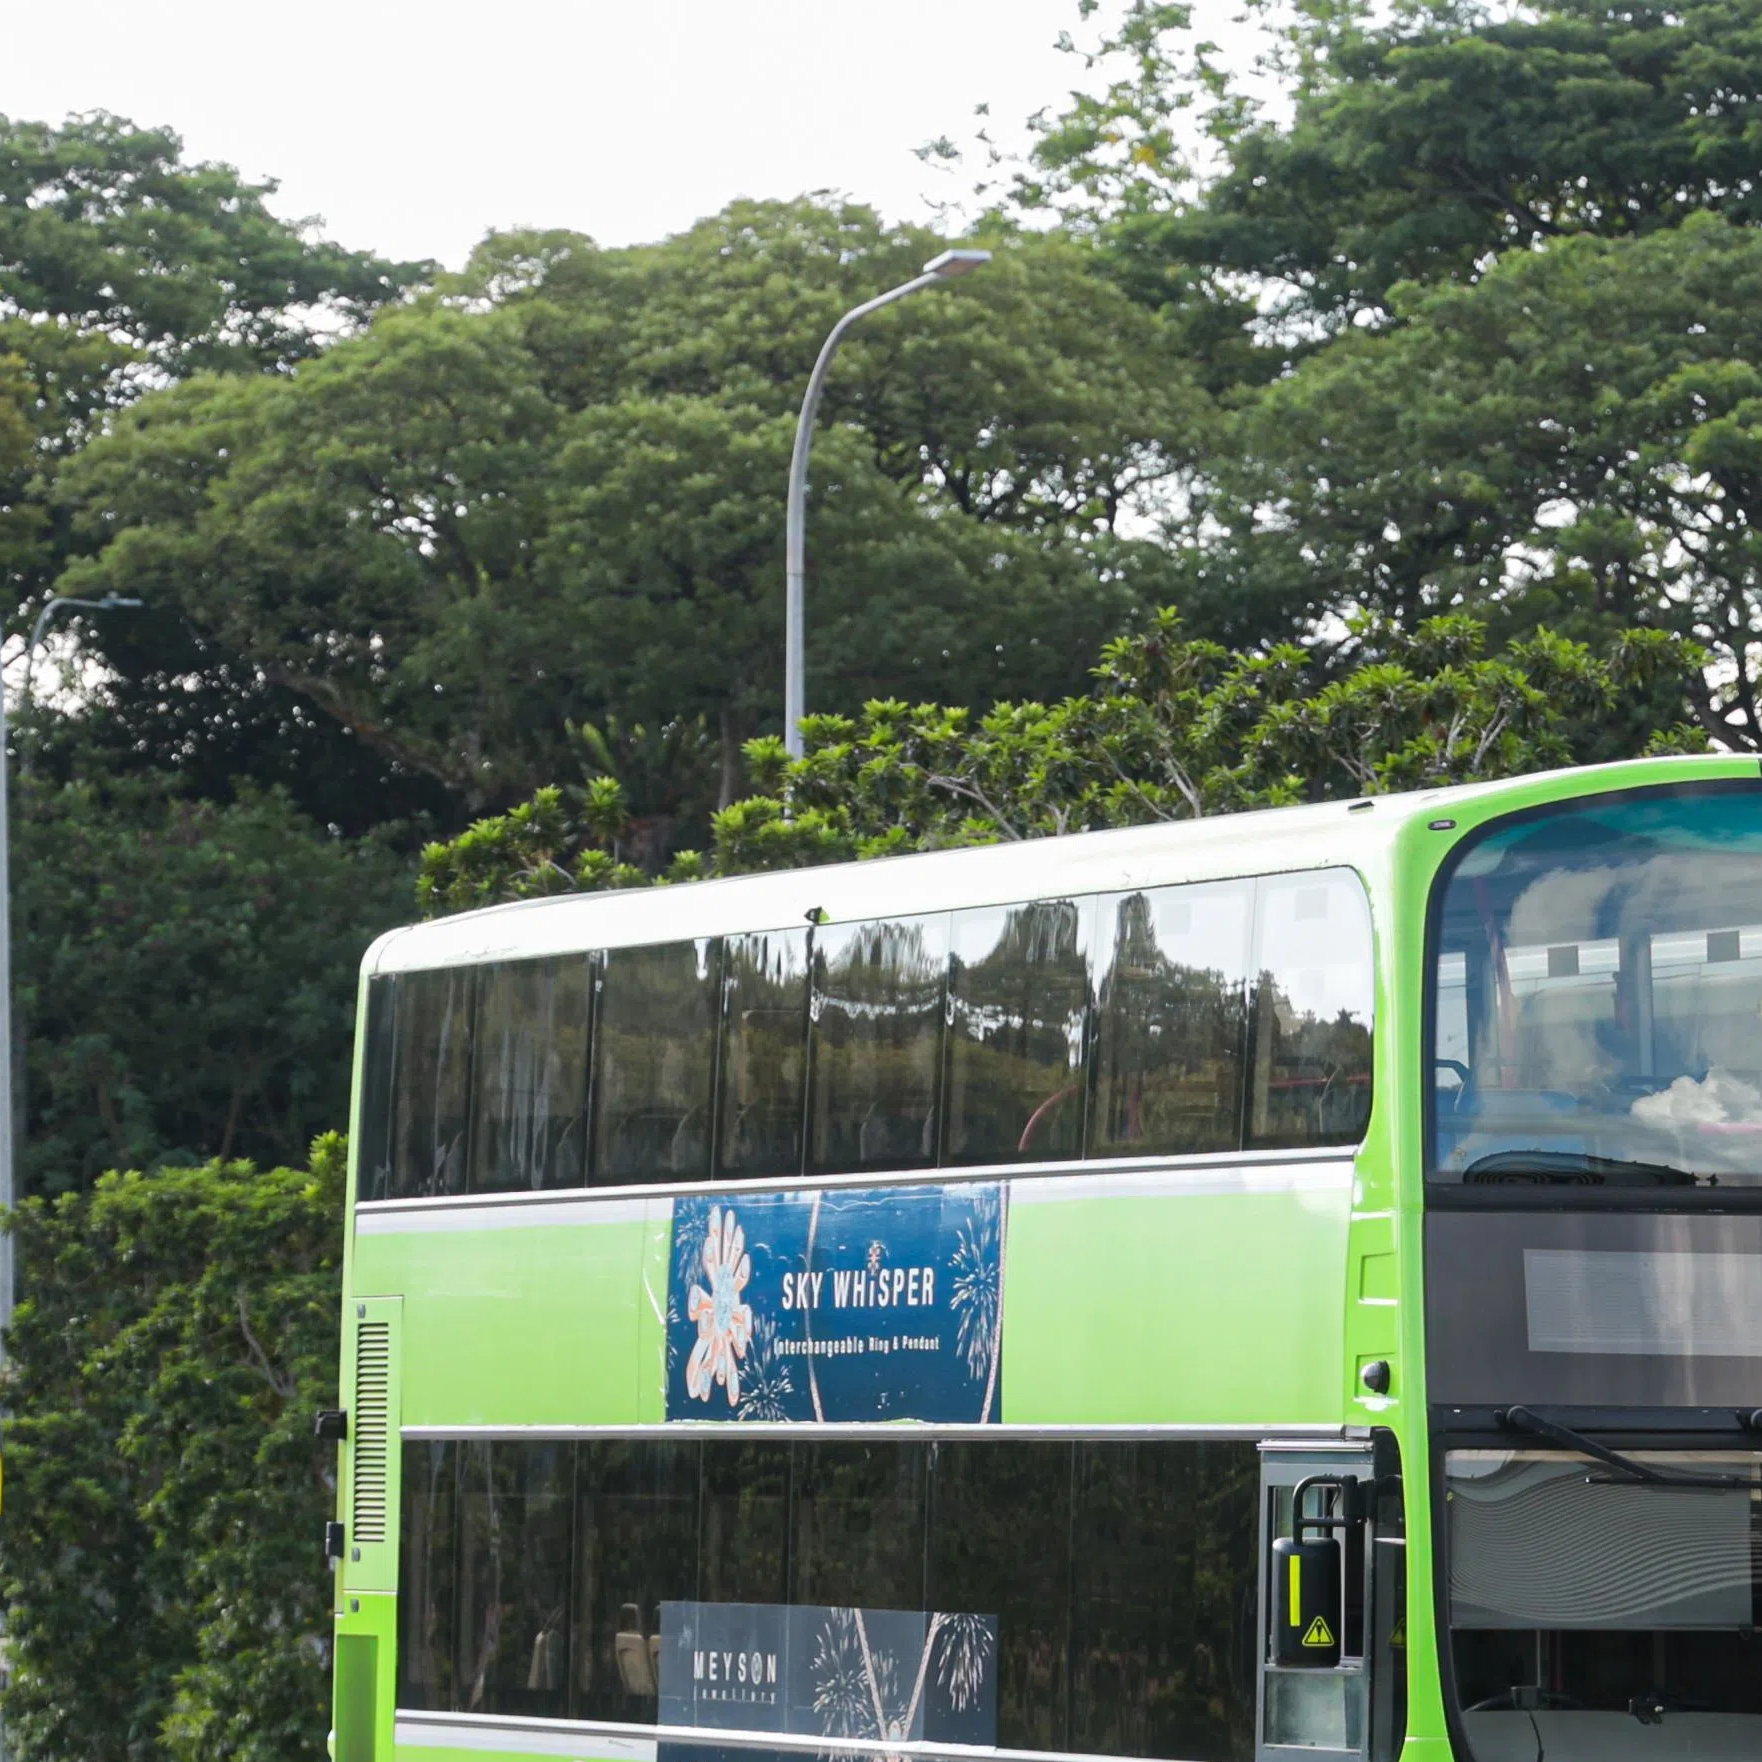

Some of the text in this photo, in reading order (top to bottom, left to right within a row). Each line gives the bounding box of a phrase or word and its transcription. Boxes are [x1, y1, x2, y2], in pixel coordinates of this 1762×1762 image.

[782, 1272, 823, 1310] SKY
[773, 1334, 940, 1358] Interchangeable Ring & Pendant
[693, 1651, 777, 1685] MEYSON
